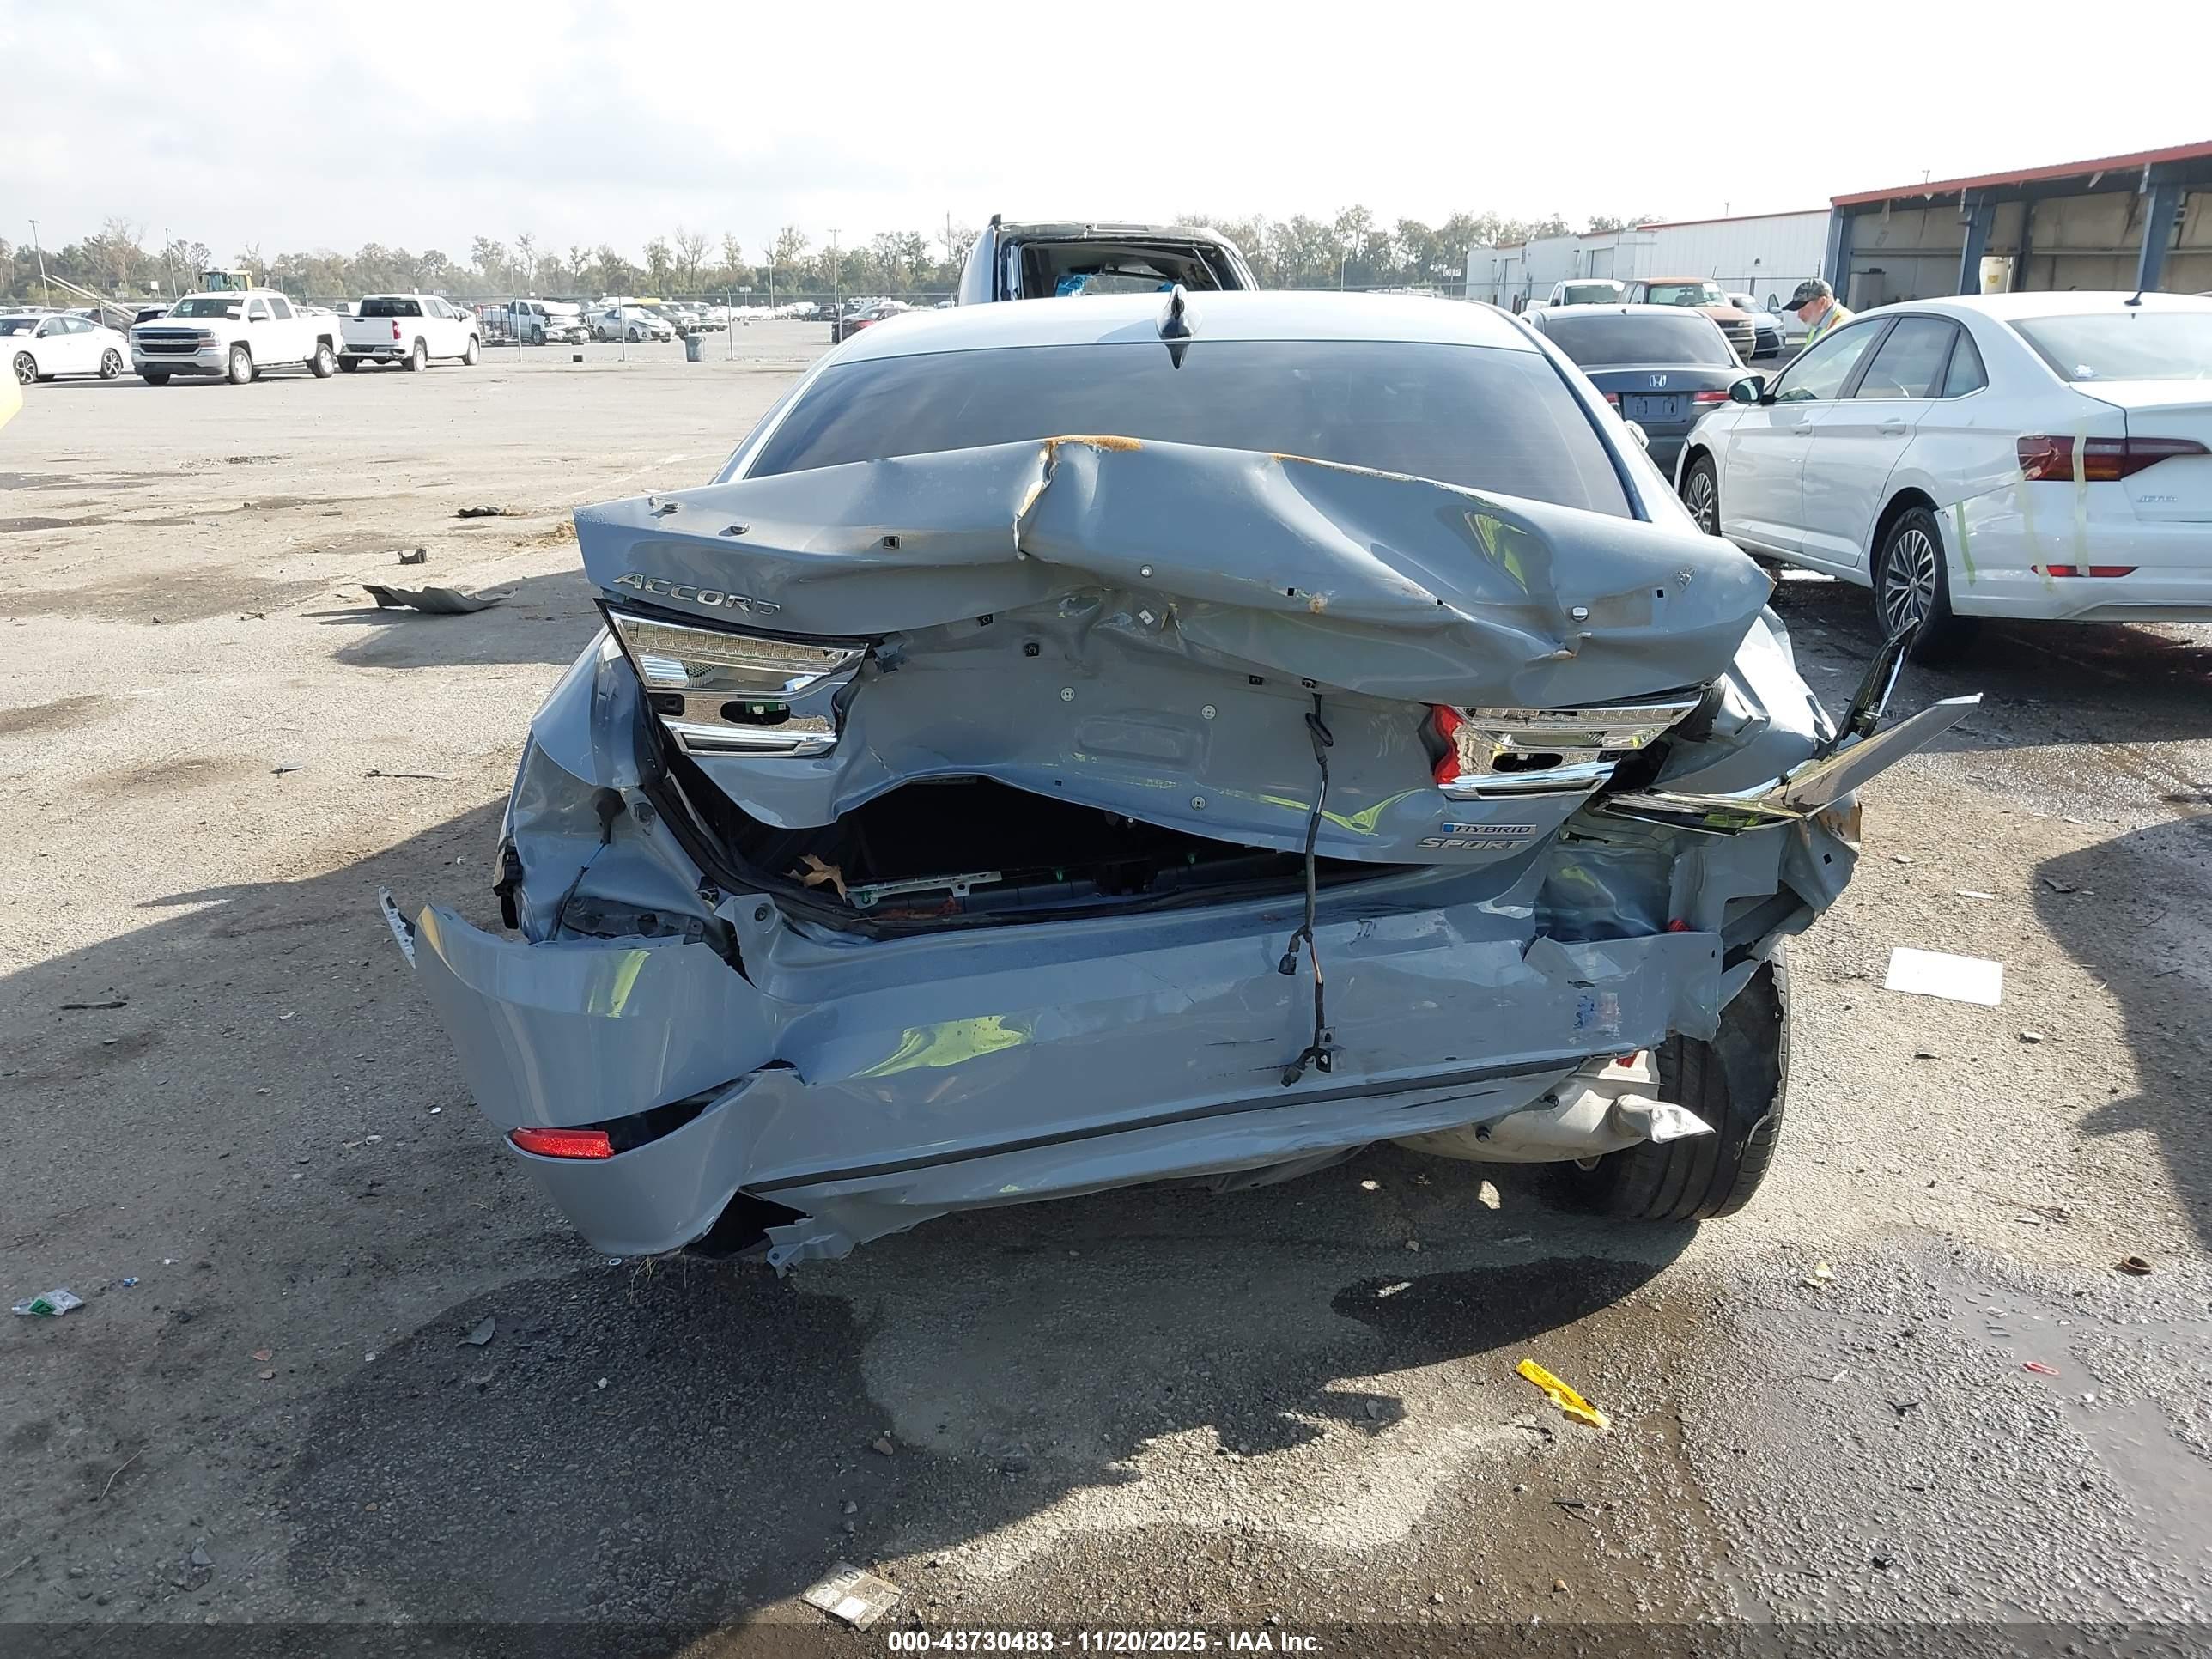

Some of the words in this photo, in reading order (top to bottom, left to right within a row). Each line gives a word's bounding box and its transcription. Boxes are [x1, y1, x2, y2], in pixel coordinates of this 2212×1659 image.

[612, 572, 781, 615] ACCORD
[1456, 825, 1531, 834] HYBRID
[1418, 838, 1531, 849] SPORT
